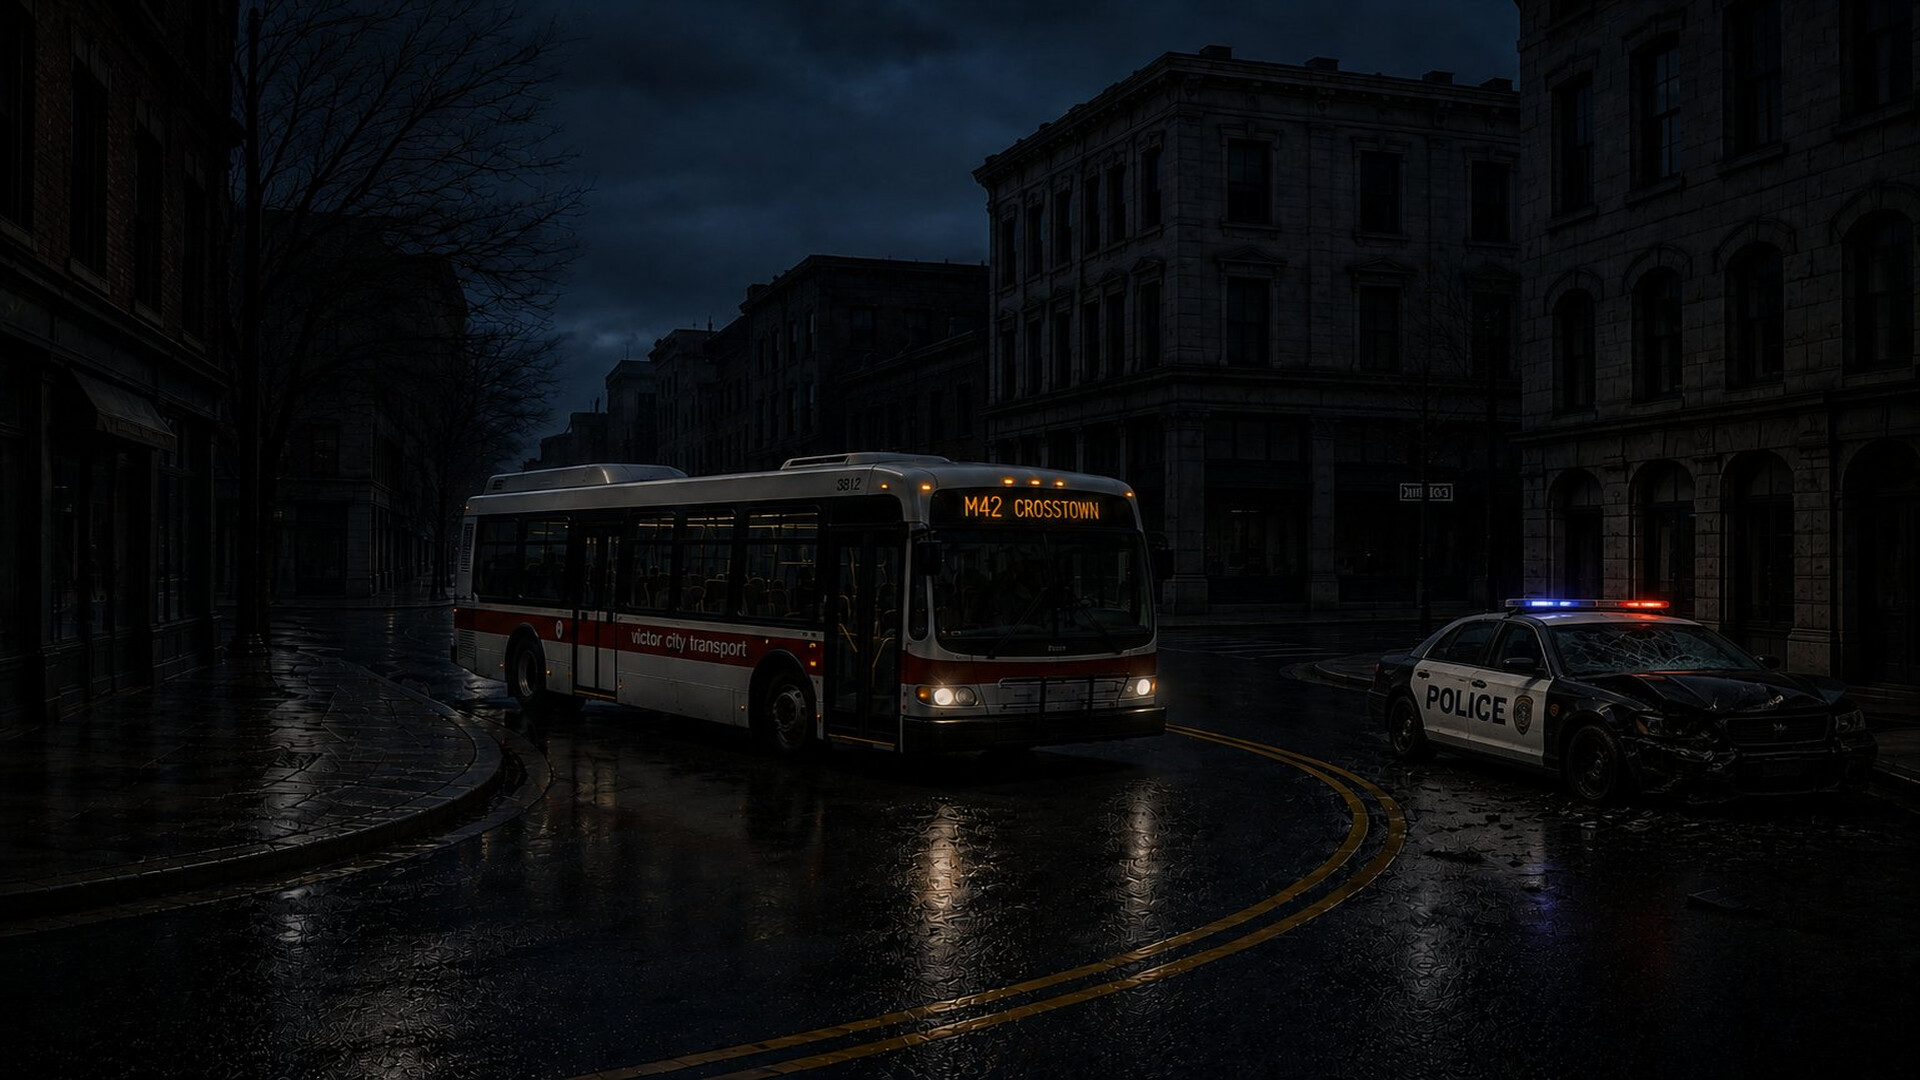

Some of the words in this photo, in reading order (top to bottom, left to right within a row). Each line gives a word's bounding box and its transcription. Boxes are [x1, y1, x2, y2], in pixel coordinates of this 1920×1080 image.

[837, 478, 861, 491] 3812
[964, 495, 1003, 518] M42
[1014, 498, 1100, 520] CROSSTOWN
[631, 628, 663, 647] victor
[665, 632, 687, 654] city
[689, 636, 748, 659] transport
[1426, 684, 1508, 726] POLICE
